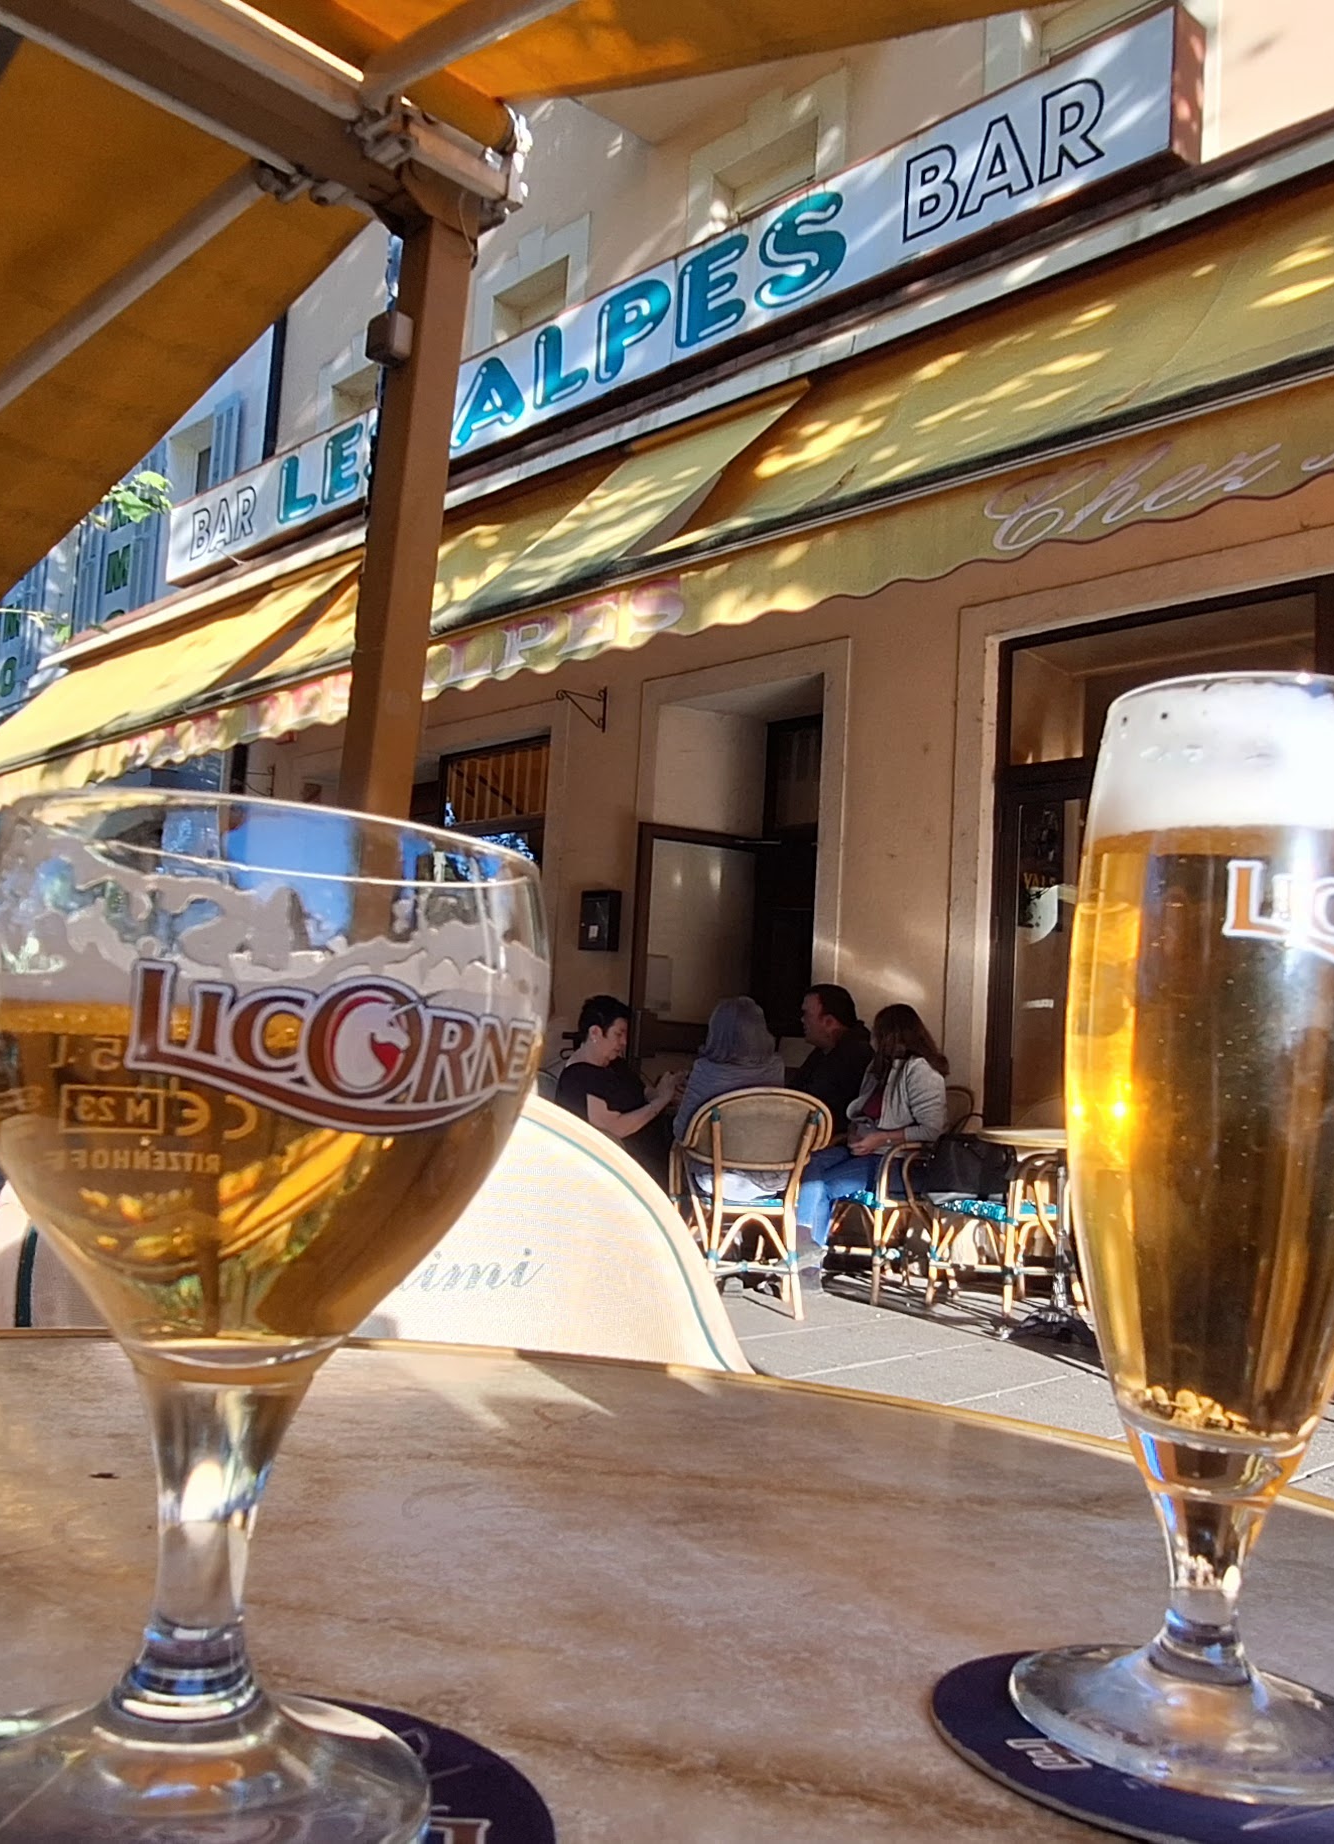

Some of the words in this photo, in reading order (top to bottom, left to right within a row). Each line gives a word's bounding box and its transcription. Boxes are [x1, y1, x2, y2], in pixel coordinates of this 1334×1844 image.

[189, 486, 258, 562] BAR
[277, 422, 378, 524] LE
[449, 191, 848, 450] ALPES
[903, 78, 1105, 243] BAR
[983, 439, 1282, 553] Chez
[423, 576, 685, 690] LPES
[124, 957, 539, 1106] LICORNE
[400, 1247, 545, 1292] imi
